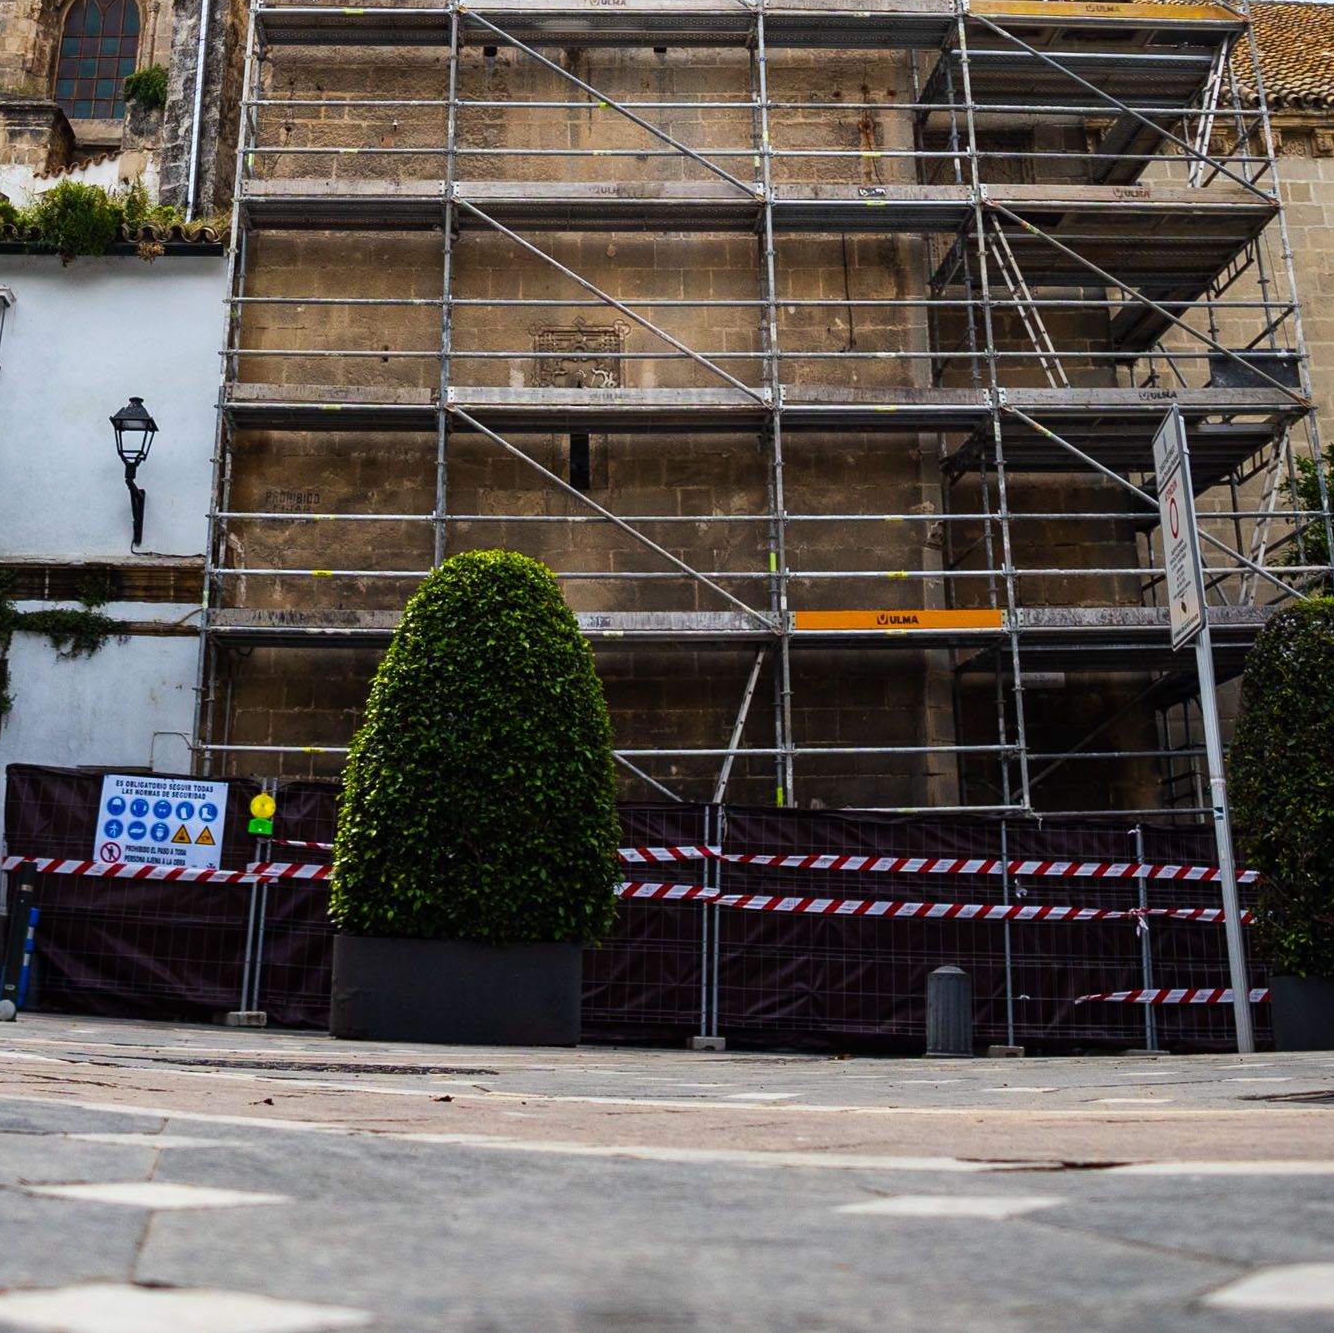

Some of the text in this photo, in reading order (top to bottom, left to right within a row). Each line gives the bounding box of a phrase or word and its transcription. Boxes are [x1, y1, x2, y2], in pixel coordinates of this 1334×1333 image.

[1095, 5, 1121, 13] ULMA
[1123, 190, 1151, 199] ULMA
[1150, 390, 1178, 400] ULMA
[266, 490, 320, 505] PROHIBIDO
[889, 616, 920, 626] ULMA
[125, 780, 168, 790] OBLIGATORIO
[169, 784, 192, 792] SEGUIR
[135, 789, 160, 797] NORMAS
[172, 792, 206, 800] SEGURIDAD
[125, 845, 150, 854] PROHIBIDO
[124, 855, 146, 863] PERSONA
[147, 857, 161, 865] AJENA
